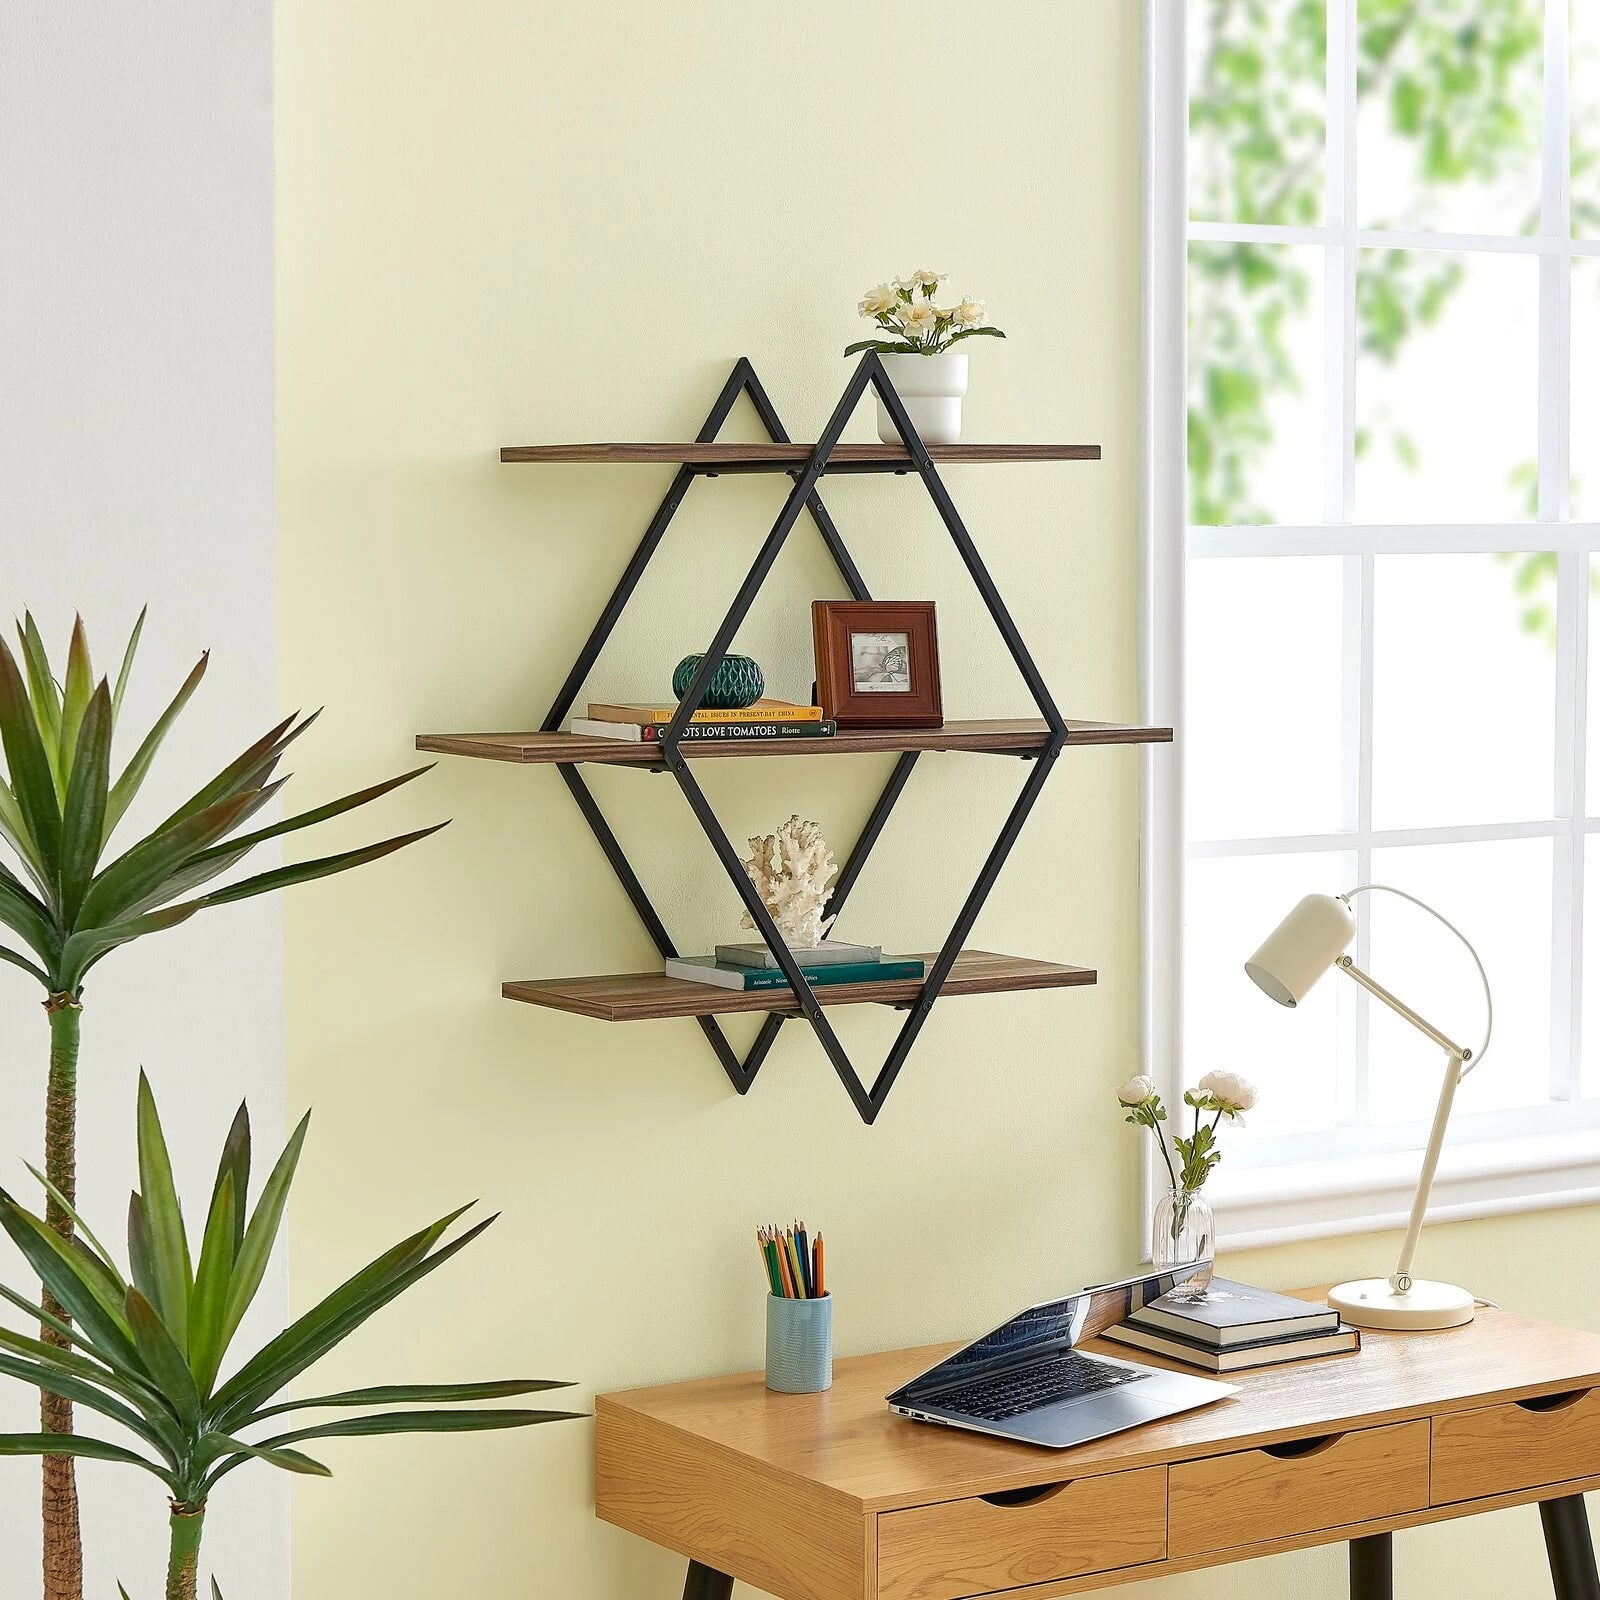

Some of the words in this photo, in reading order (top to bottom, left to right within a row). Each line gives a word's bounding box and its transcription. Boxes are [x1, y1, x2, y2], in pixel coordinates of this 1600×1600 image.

[658, 727, 699, 738] COTS
[702, 727, 725, 737] LOVE
[727, 725, 776, 737] TOMATOES
[781, 726, 801, 734] Riotte
